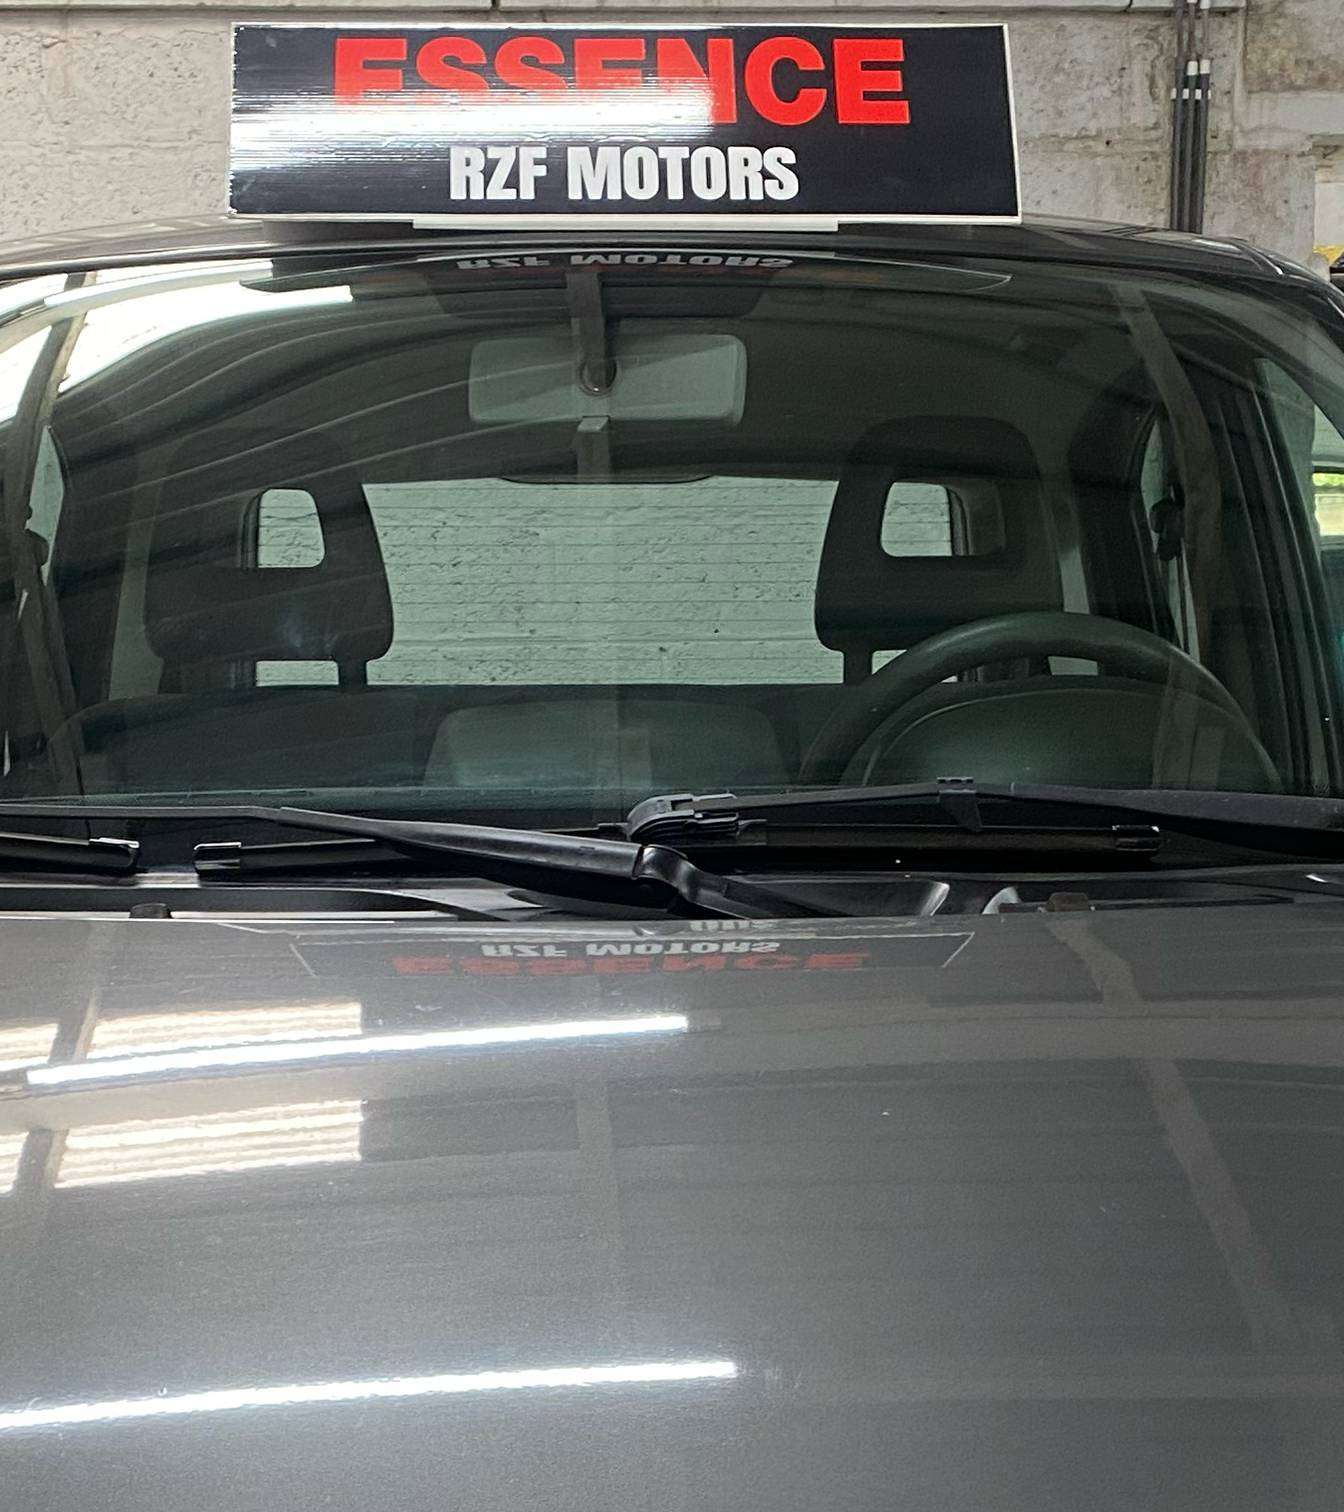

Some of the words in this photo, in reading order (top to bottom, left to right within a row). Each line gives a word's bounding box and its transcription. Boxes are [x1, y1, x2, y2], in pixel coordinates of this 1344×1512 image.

[333, 35, 911, 126] ESSENCE
[450, 146, 547, 200] RZF
[567, 146, 800, 200] MOTORS
